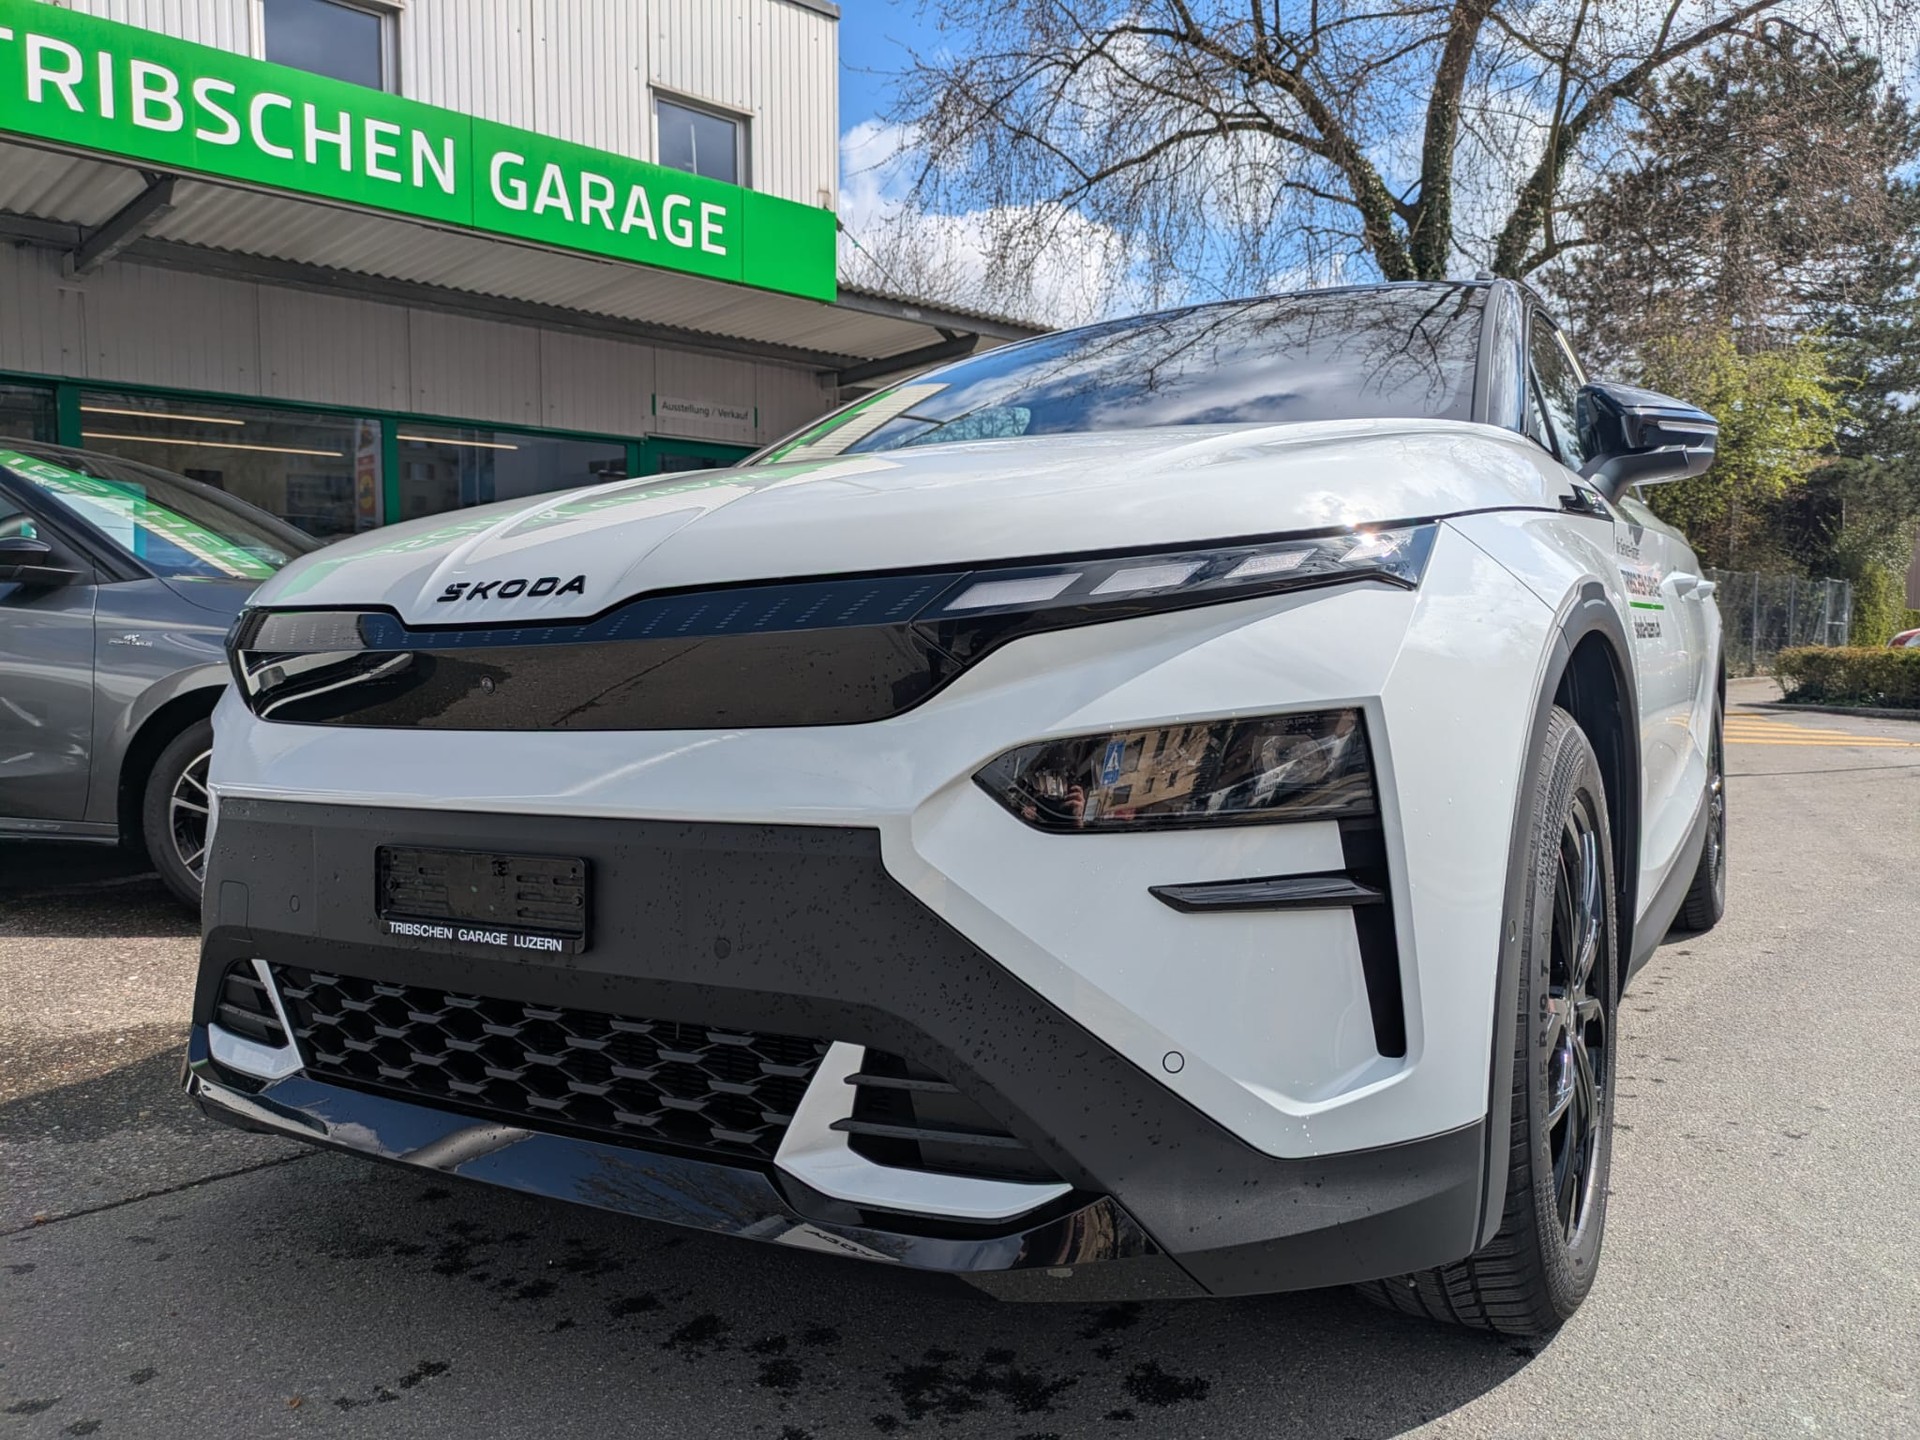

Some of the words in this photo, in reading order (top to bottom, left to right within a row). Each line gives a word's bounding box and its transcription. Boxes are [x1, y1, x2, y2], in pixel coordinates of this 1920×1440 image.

[0, 27, 456, 195] RIBSCHEN
[490, 151, 727, 256] GARAGE
[662, 401, 710, 417] Ausstellung
[718, 409, 748, 420] Verkauf
[389, 921, 452, 939] TRIBSCHEN
[458, 929, 508, 945] GARAGE
[514, 935, 562, 952] LUZERN
